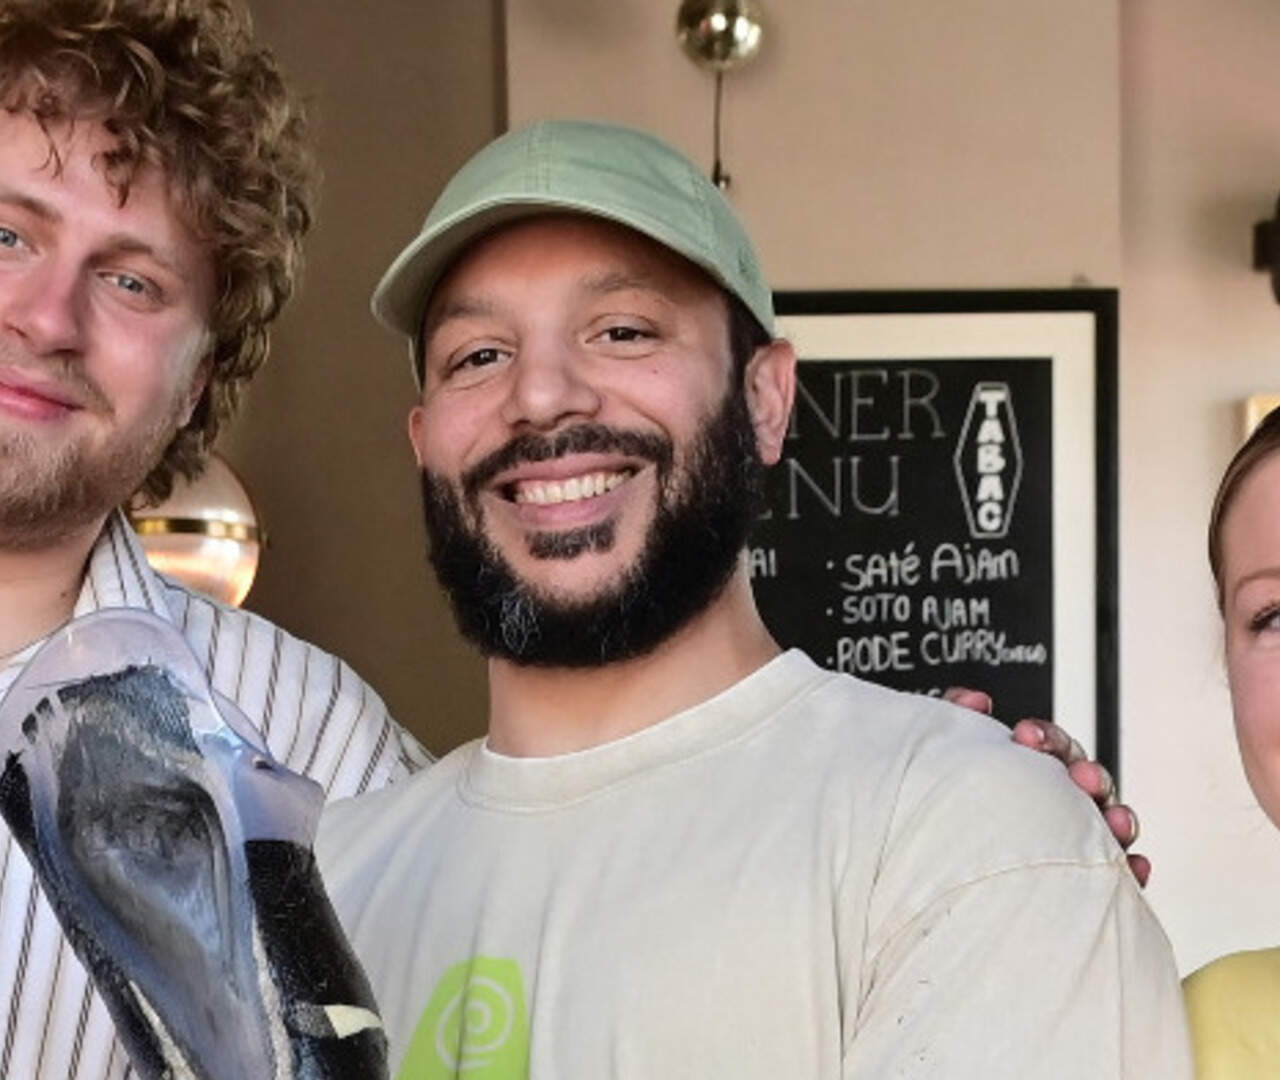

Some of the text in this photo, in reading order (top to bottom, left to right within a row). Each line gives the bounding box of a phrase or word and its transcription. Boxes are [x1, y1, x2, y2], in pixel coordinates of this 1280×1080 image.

[757, 454, 901, 519] NU
[976, 390, 1007, 532] TABAC
[842, 593, 911, 624] SOTO
[836, 631, 915, 673] RODE
[921, 628, 1006, 665] CURRY
